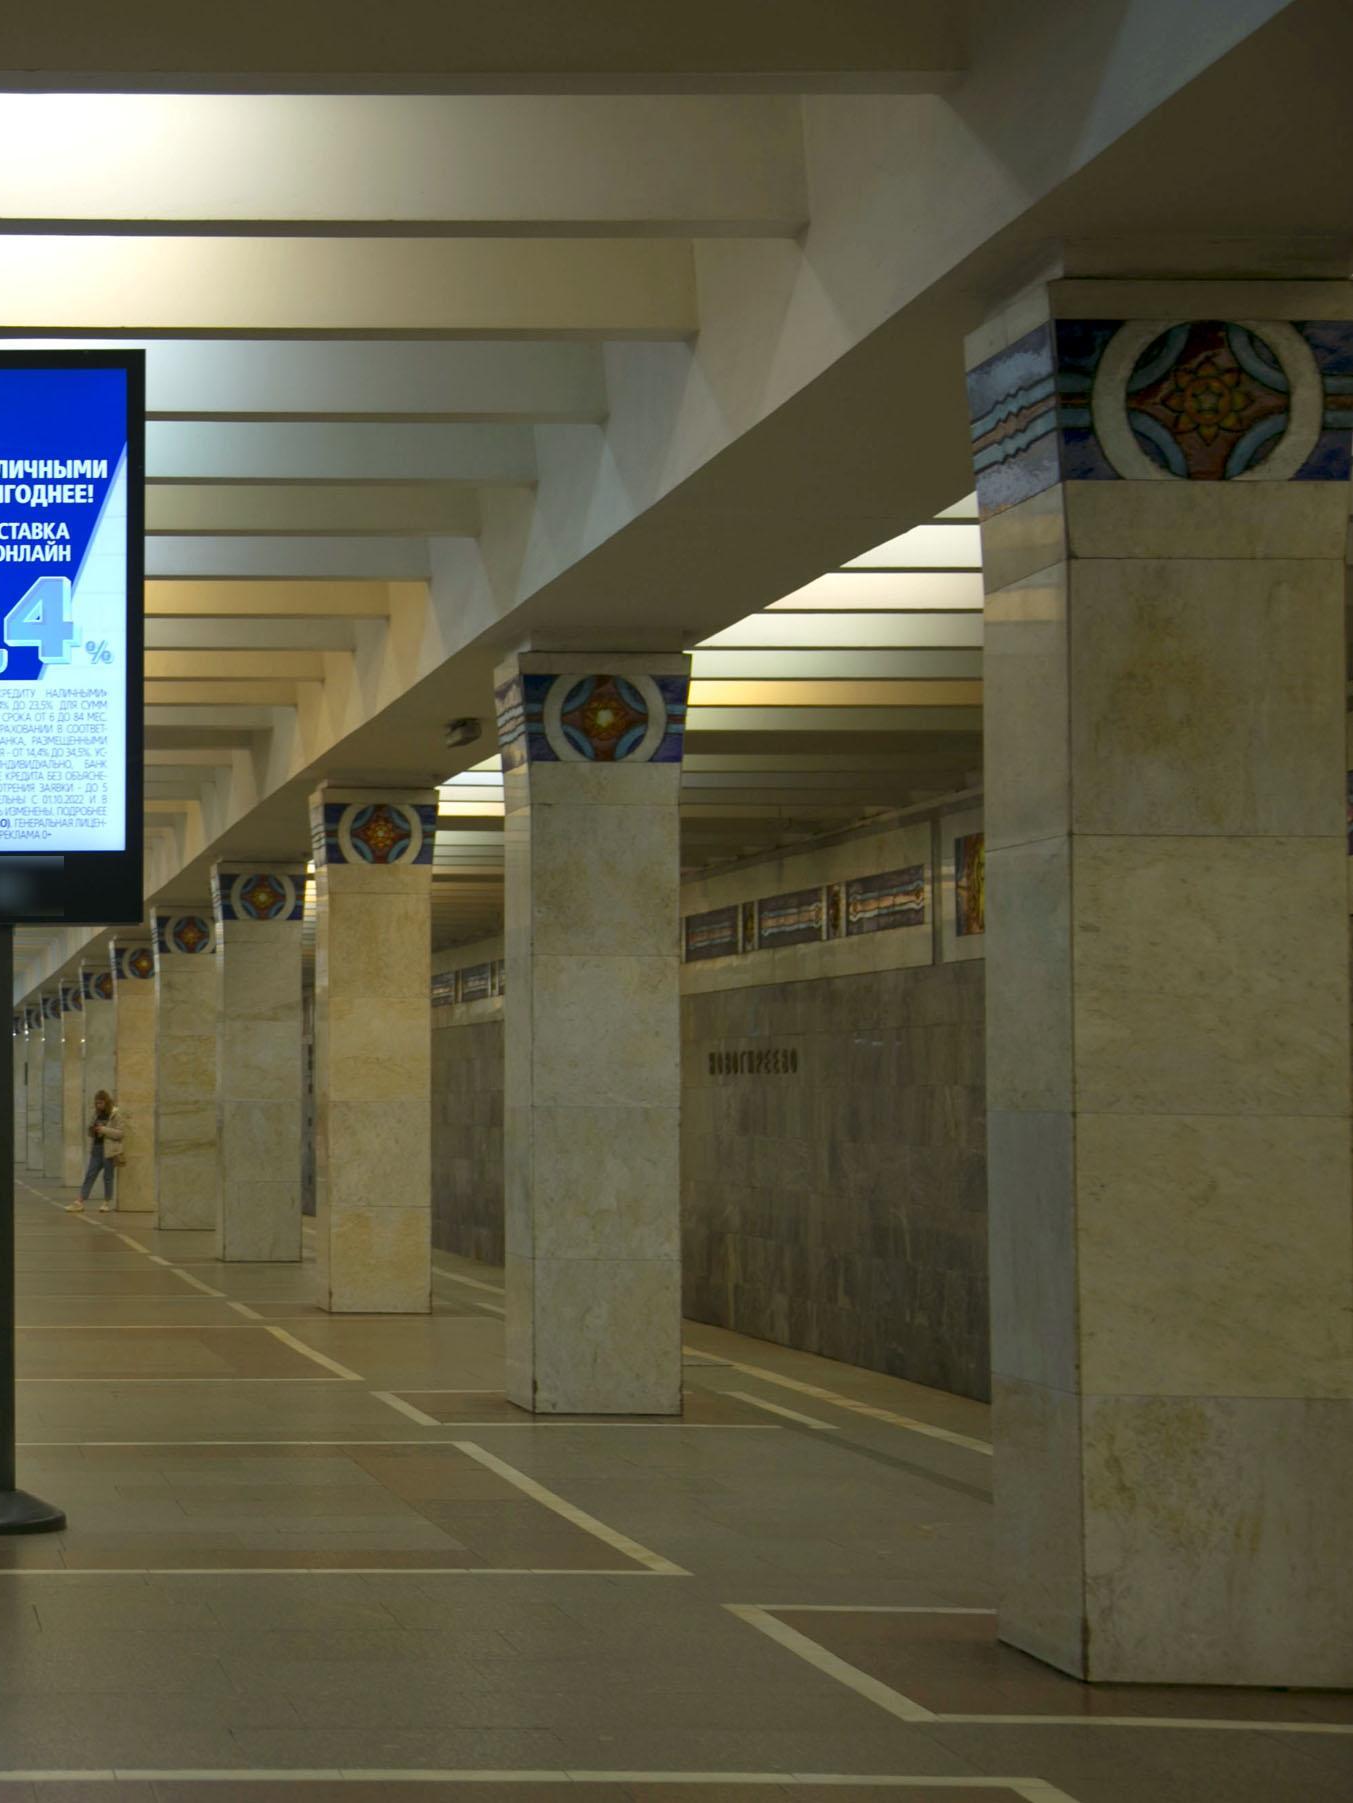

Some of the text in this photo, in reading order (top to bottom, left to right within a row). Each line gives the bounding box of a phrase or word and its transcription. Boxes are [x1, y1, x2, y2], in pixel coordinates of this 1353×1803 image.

[12, 700, 26, 711] ДО
[59, 700, 78, 711] ДЛЯ
[81, 700, 107, 711] СУММ
[2, 712, 32, 722] СРОКА
[35, 712, 46, 722] ОТ
[58, 712, 71, 722] ДО
[51, 748, 65, 758] ДО
[84, 759, 107, 770] БАНК
[6, 771, 44, 781] КРЕДИТА
[47, 771, 62, 781] БЕЗ
[39, 783, 74, 793] ЗАЯВКИ
[85, 783, 99, 793] ДО
[103, 783, 108, 793] 5
[31, 794, 38, 805] С
[90, 794, 96, 805] И
[57, 806, 107, 817] ПОДРОБНЕЕ
[0, 830, 40, 840] РЕКЛАМА
